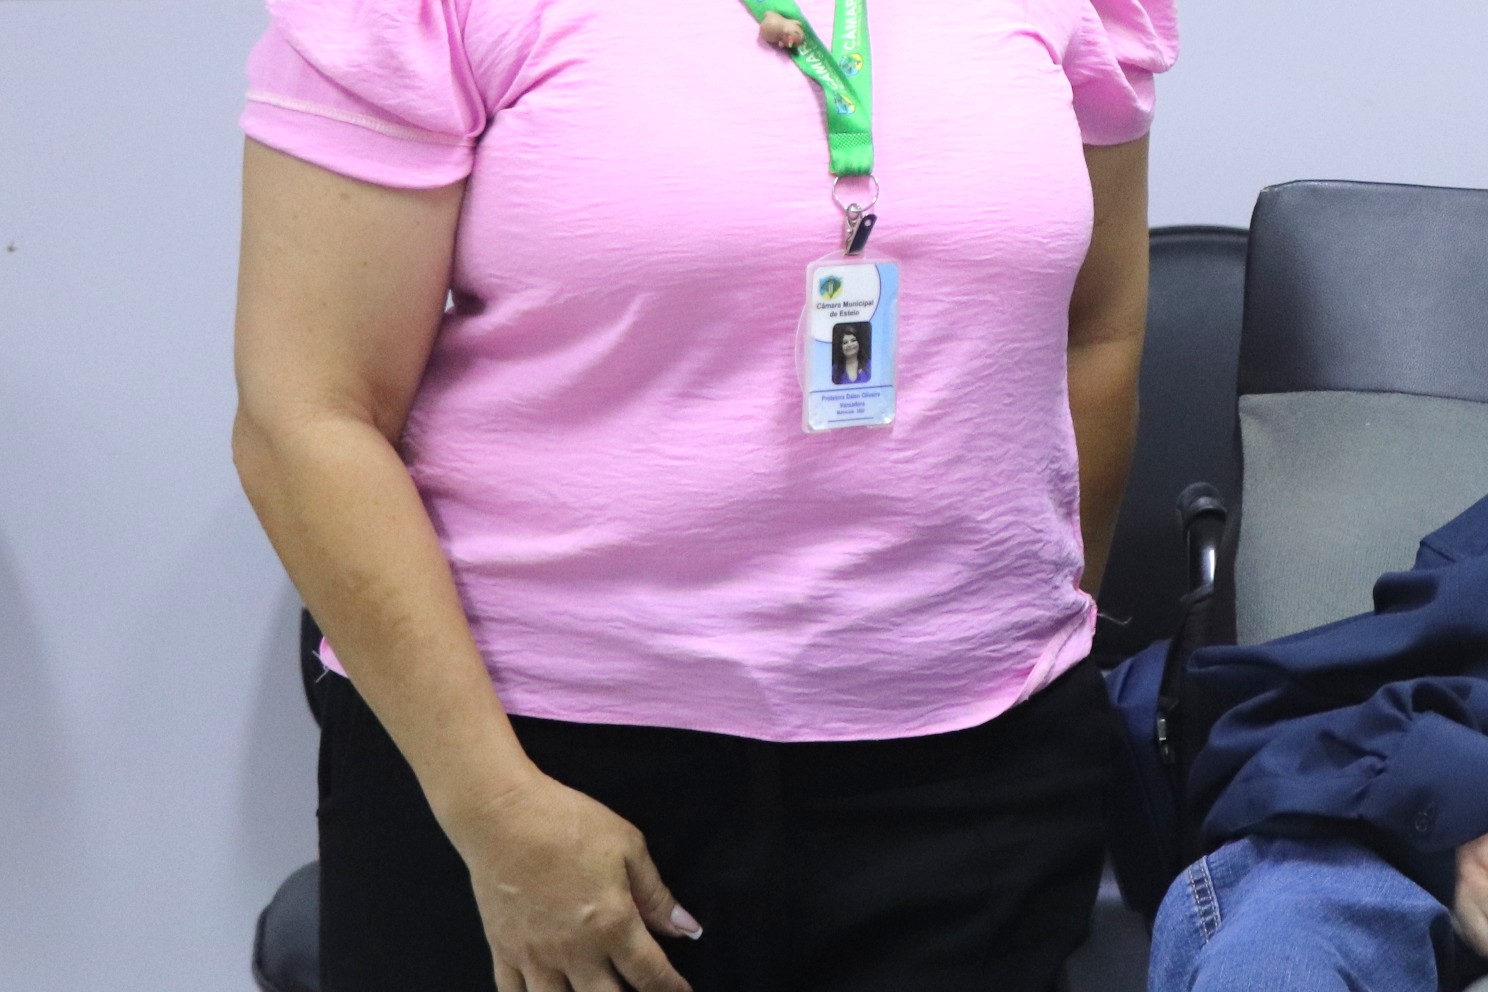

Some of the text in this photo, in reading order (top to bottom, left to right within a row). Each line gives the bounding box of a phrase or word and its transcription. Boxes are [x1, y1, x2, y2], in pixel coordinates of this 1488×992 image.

[816, 299, 874, 310] Câmara Municipal
[840, 309, 860, 317] Esteio
